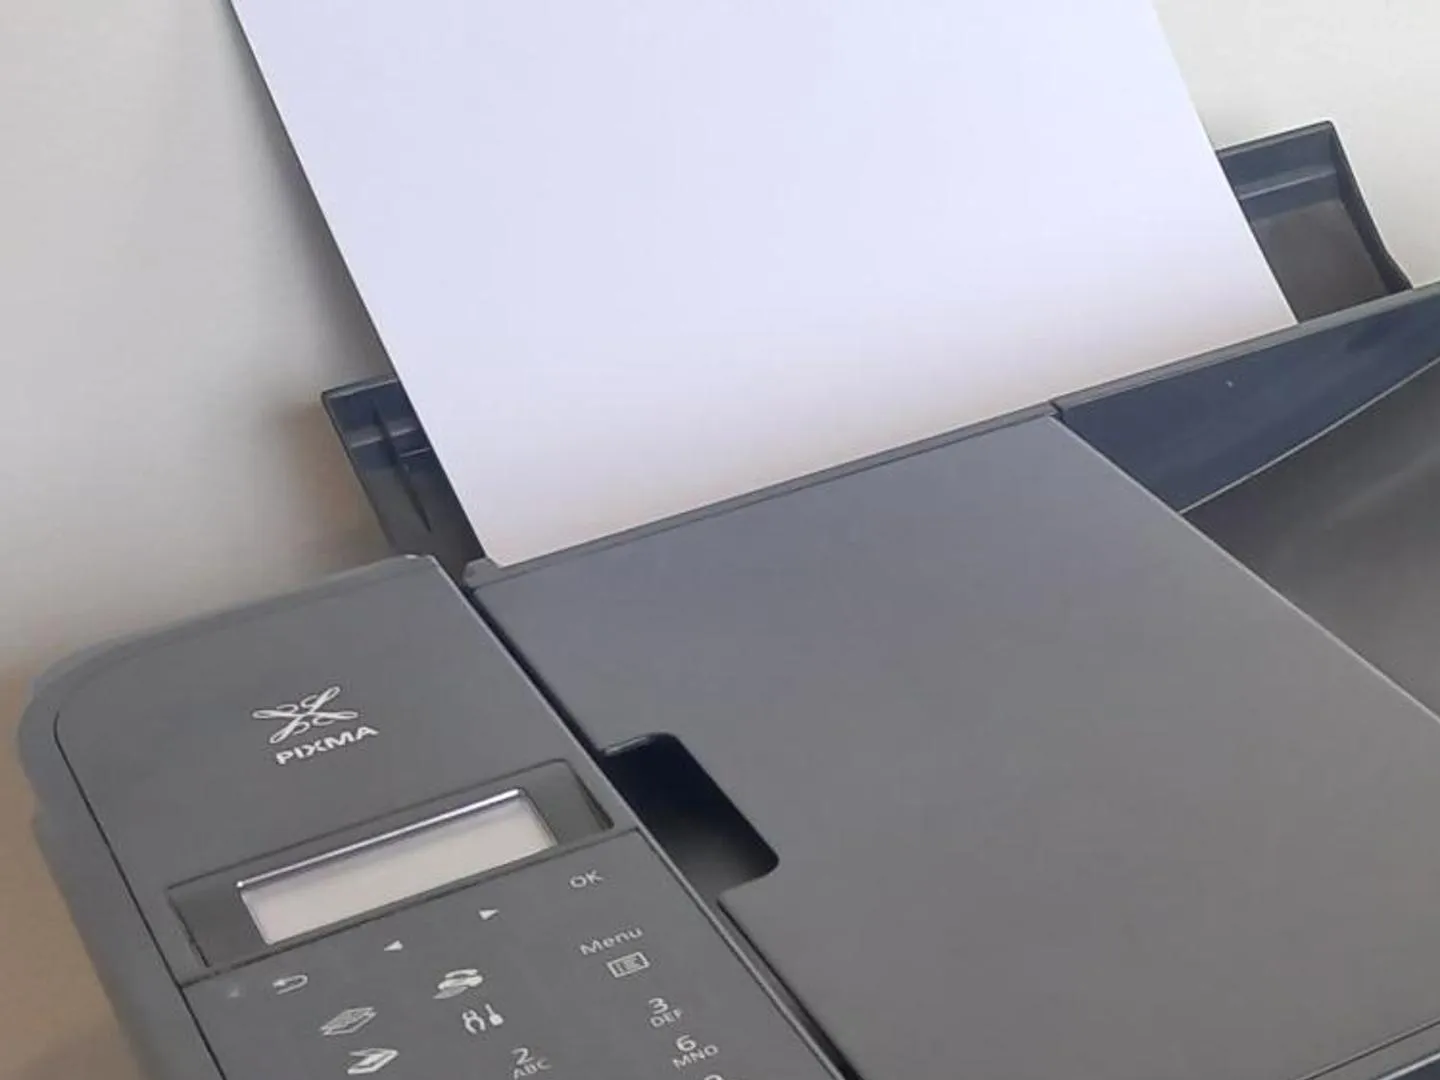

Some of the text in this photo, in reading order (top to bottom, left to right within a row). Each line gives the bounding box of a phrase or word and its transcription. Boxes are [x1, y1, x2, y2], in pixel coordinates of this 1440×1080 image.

[275, 726, 379, 765] PIXMA
[569, 869, 604, 889] OK
[580, 927, 643, 955] Menu
[649, 997, 669, 1015] 3
[650, 1008, 683, 1028] DEF
[676, 1034, 697, 1052] 6
[511, 1047, 534, 1065] 2
[672, 1044, 720, 1070] MNO
[513, 1058, 552, 1080] ABC
